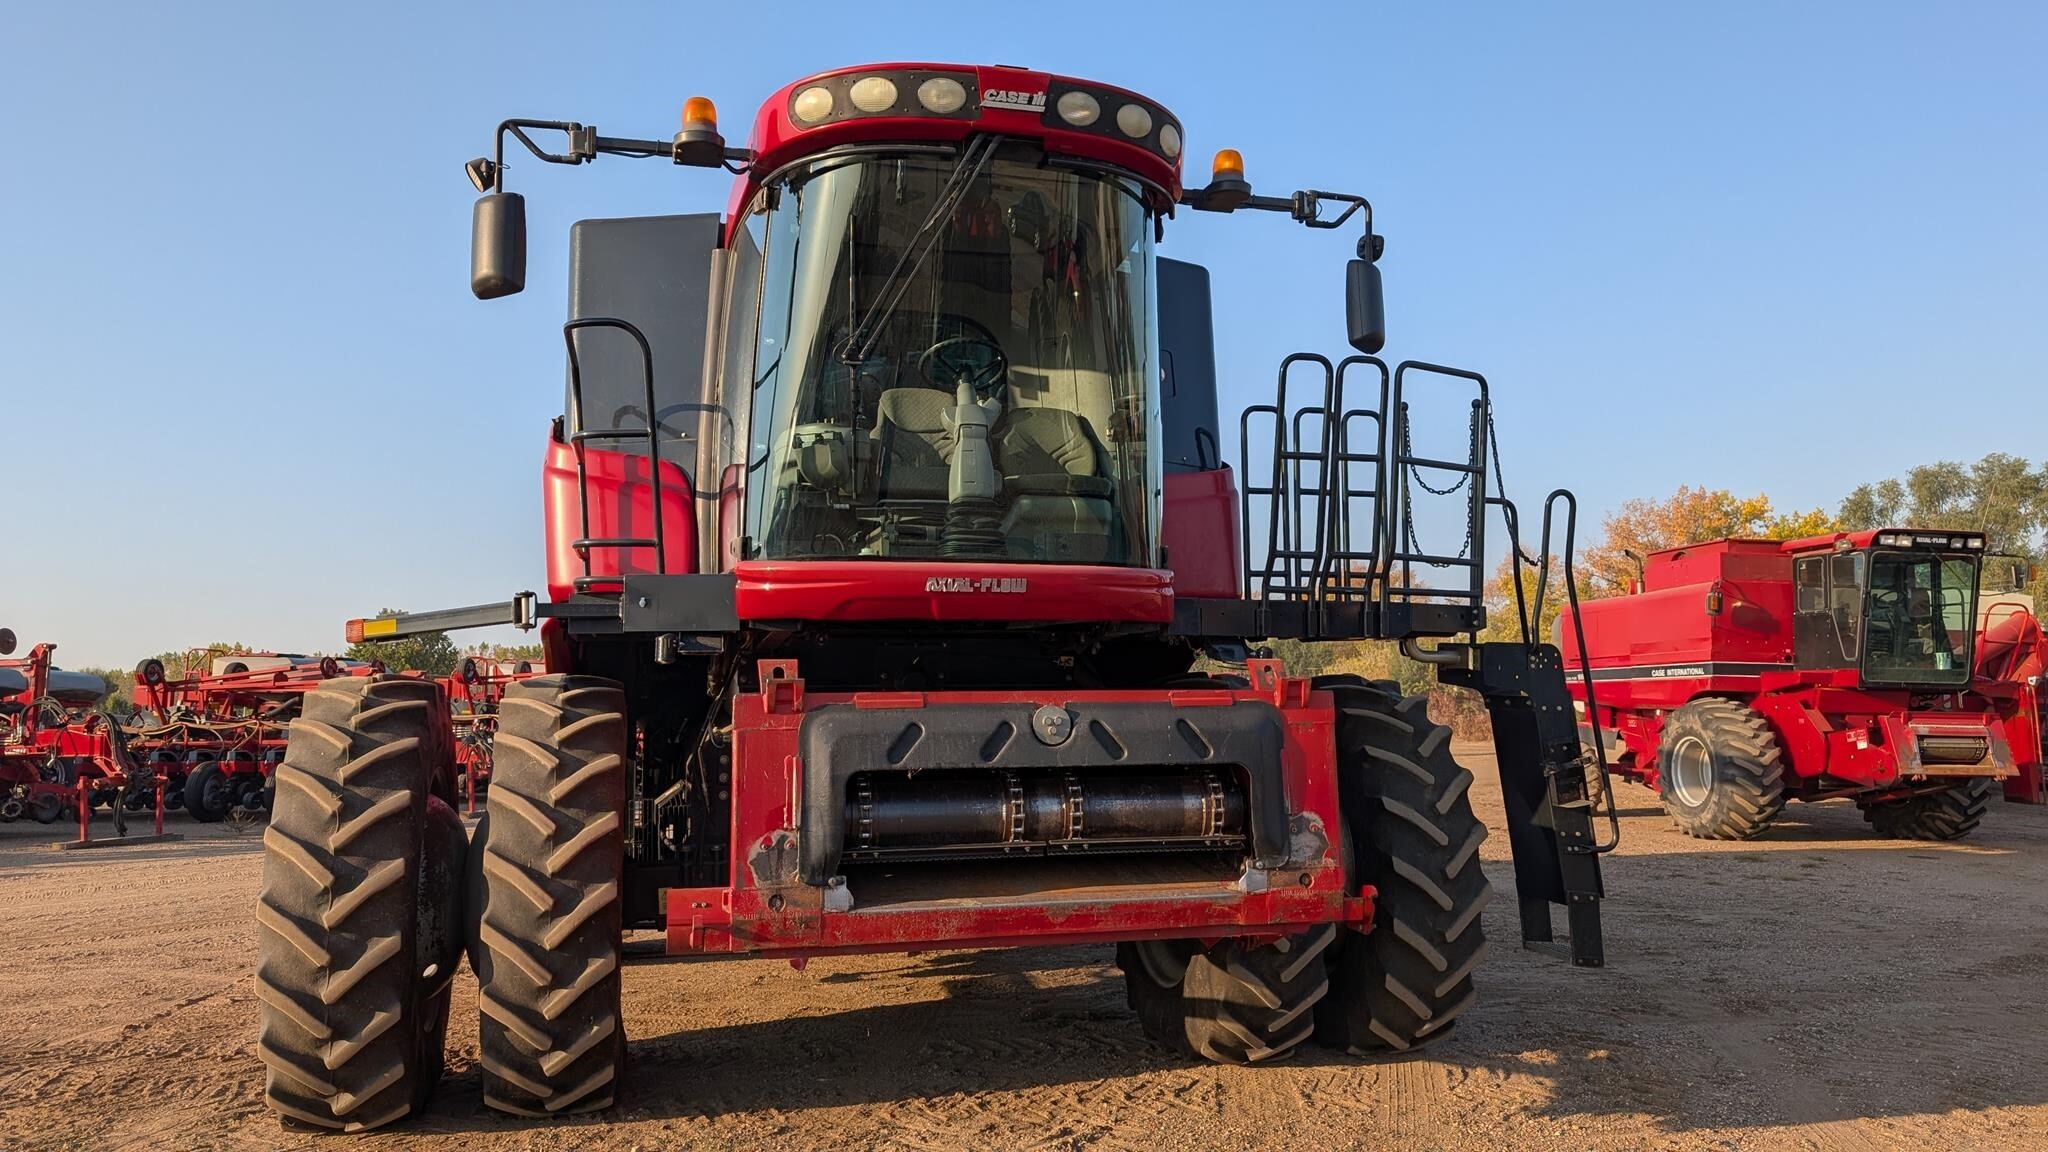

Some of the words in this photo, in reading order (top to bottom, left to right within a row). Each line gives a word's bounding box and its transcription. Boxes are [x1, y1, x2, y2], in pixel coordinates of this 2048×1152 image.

[983, 88, 1030, 104] CASE
[925, 577, 1027, 592] AXIAL-FLOW
[1651, 669, 1665, 677] CASE
[1666, 667, 1705, 676] INTERNATIONAL
